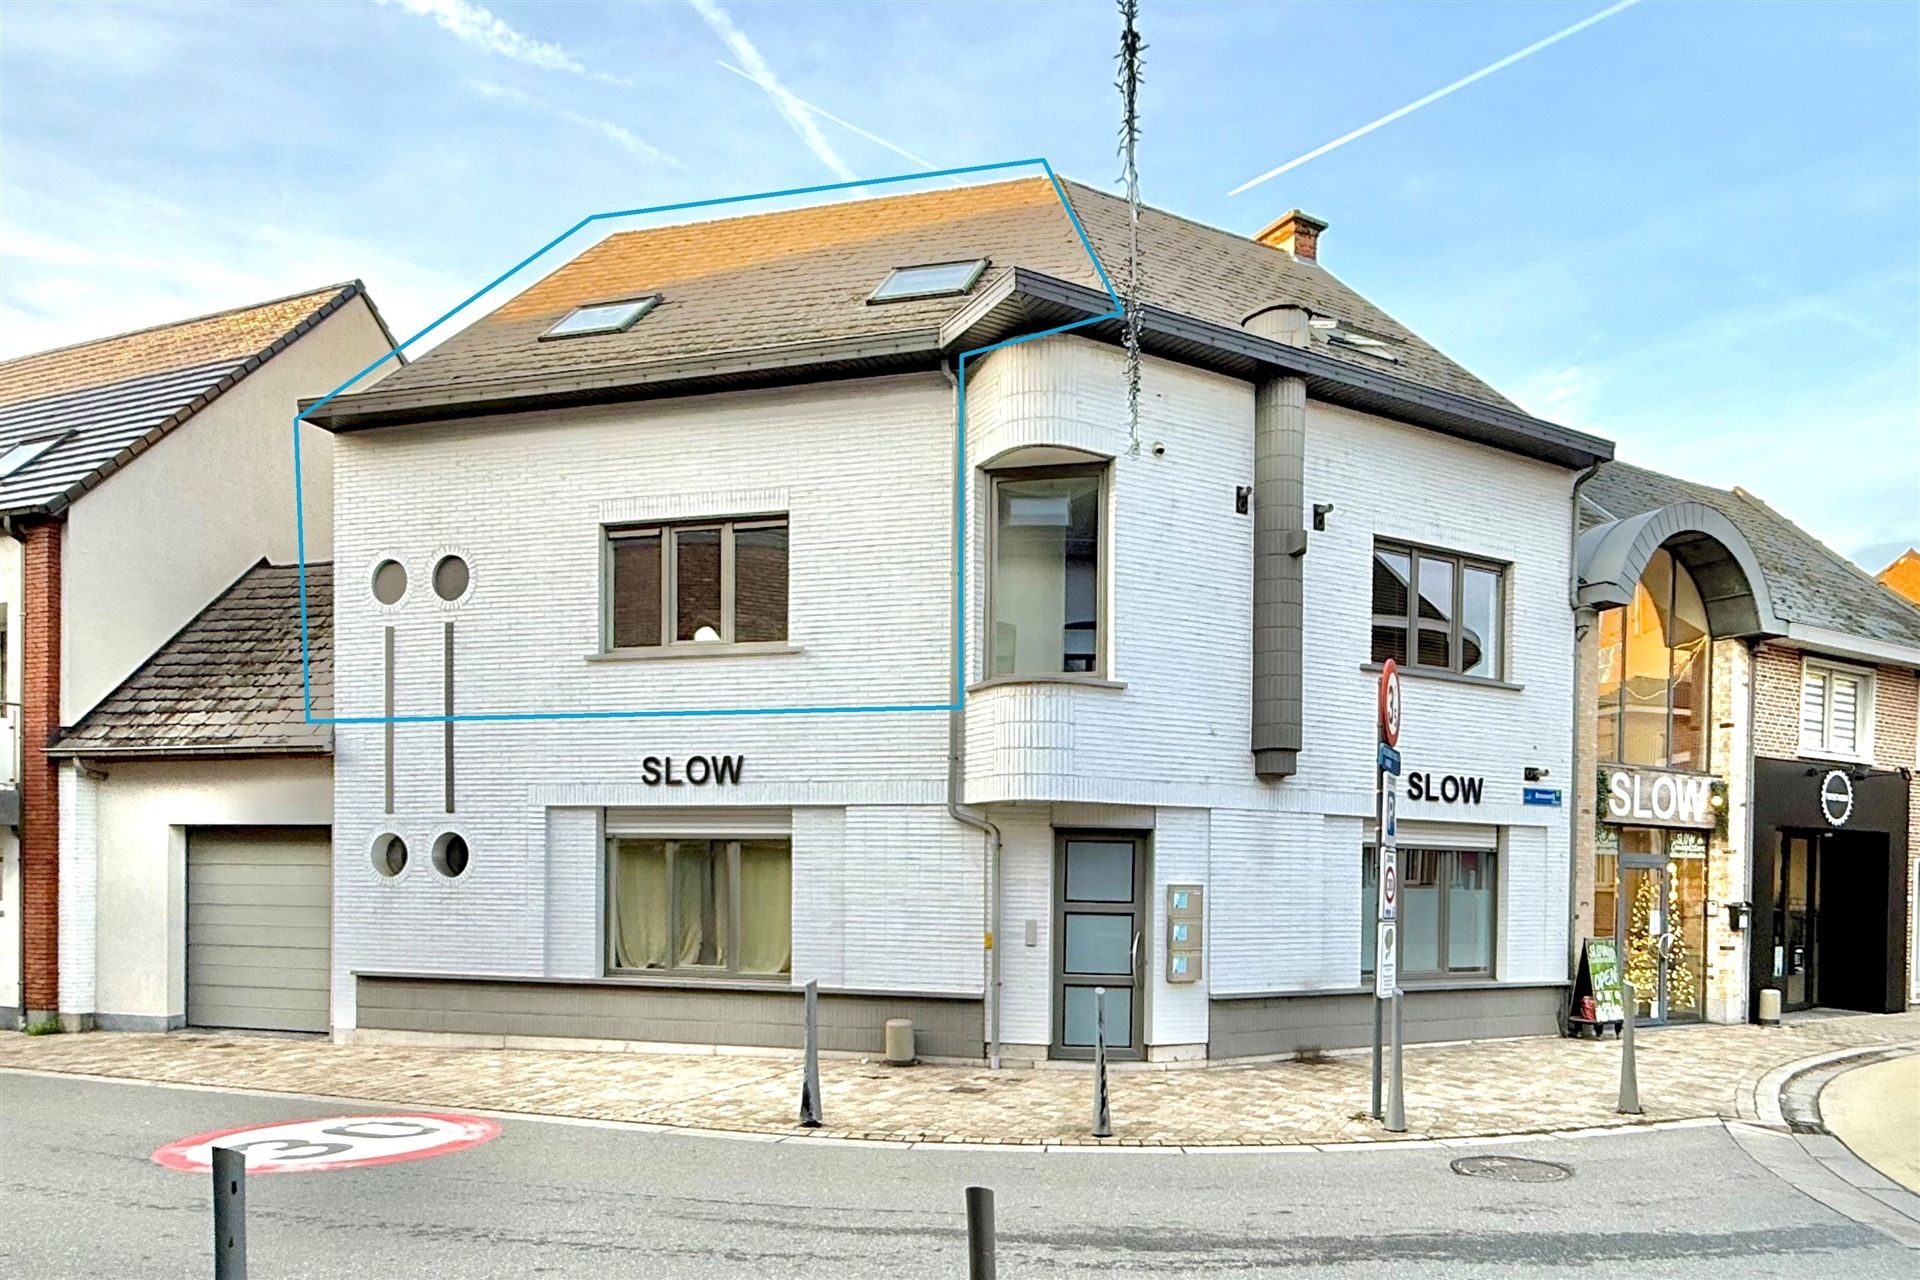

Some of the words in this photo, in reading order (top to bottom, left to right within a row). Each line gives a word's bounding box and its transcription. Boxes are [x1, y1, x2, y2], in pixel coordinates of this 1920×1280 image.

[642, 755, 743, 787] SLOW
[1408, 772, 1484, 805] SLOW
[1608, 771, 1713, 823] SLOW
[226, 1121, 440, 1161] 30
